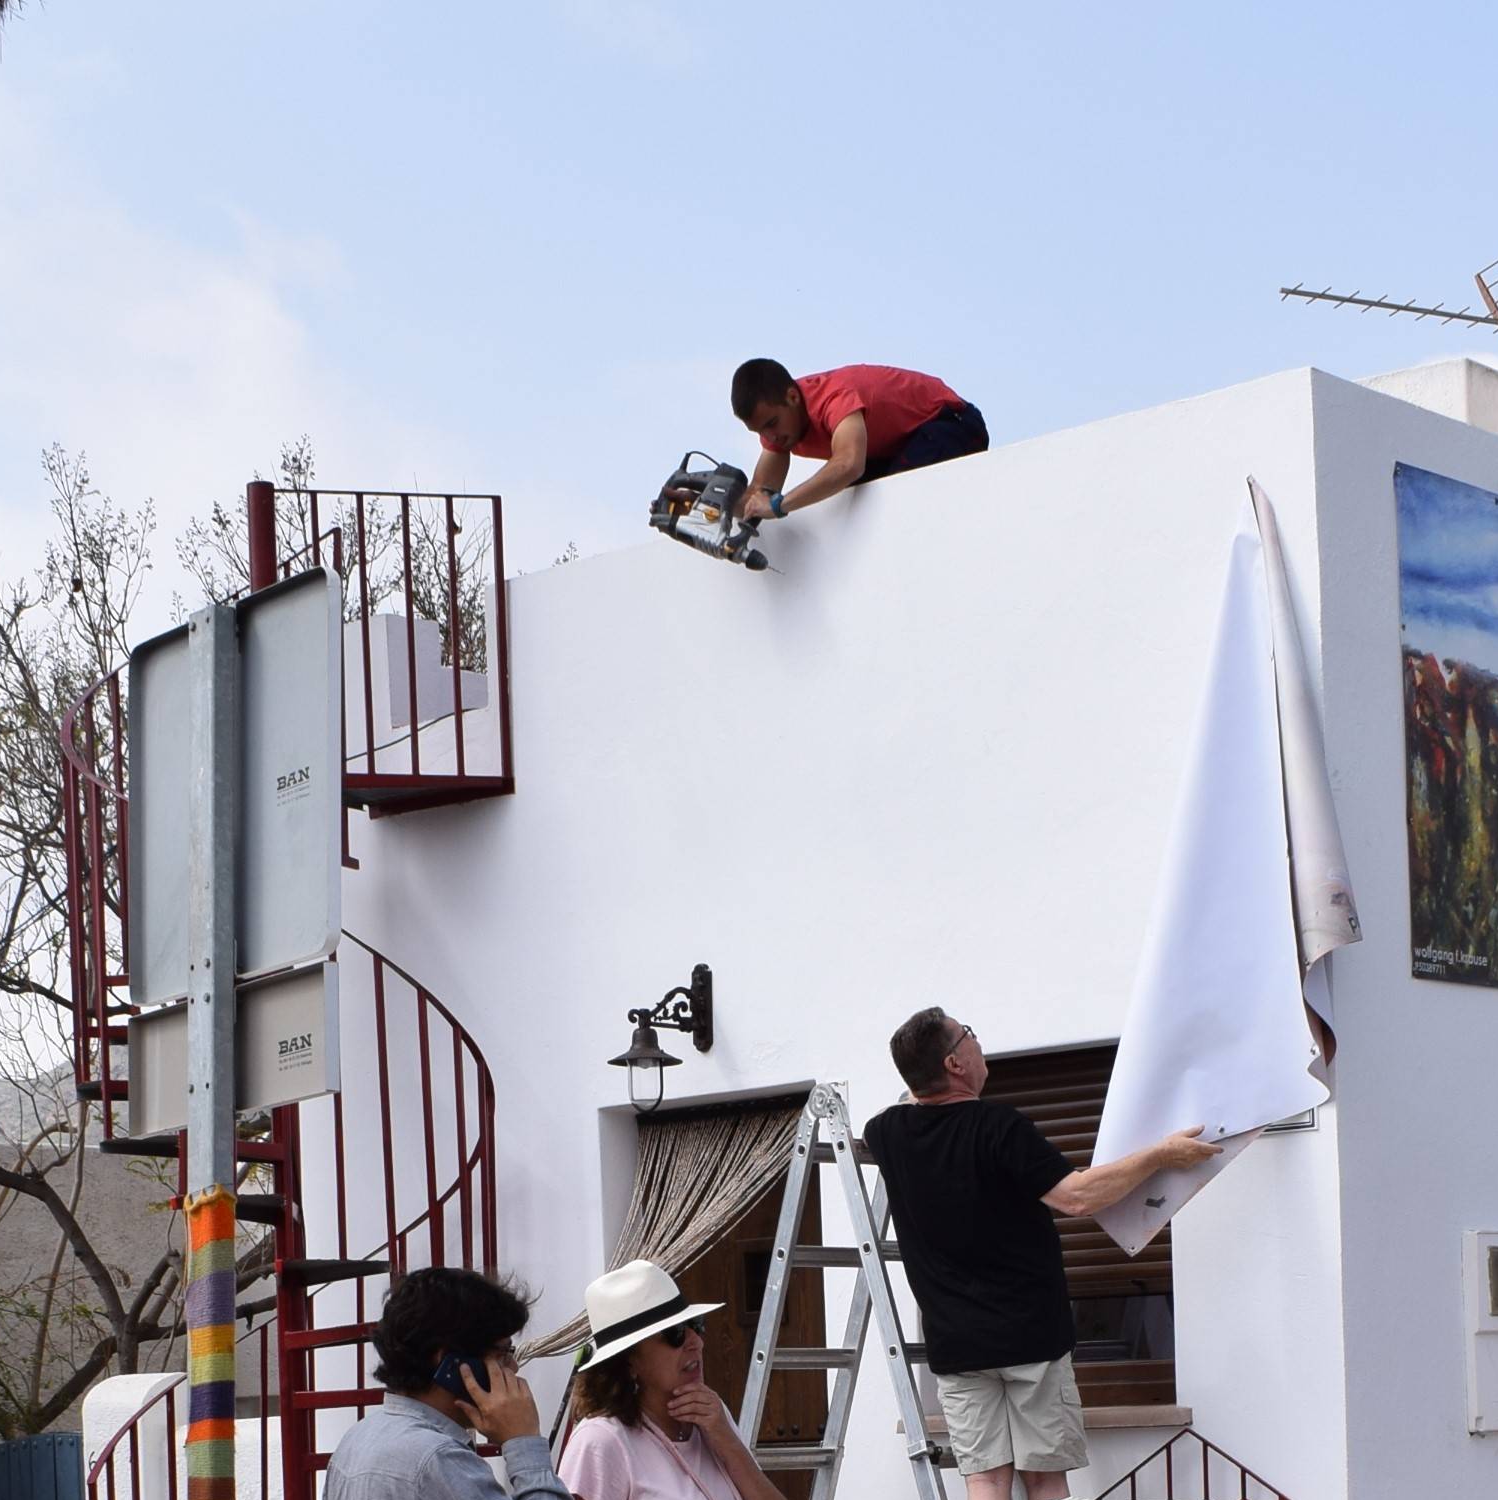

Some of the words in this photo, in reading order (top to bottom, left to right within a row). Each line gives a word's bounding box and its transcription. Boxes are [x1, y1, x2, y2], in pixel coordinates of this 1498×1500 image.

[276, 766, 310, 791] BAN
[1414, 943, 1454, 965] wolfgang
[278, 1033, 312, 1055] BAN
